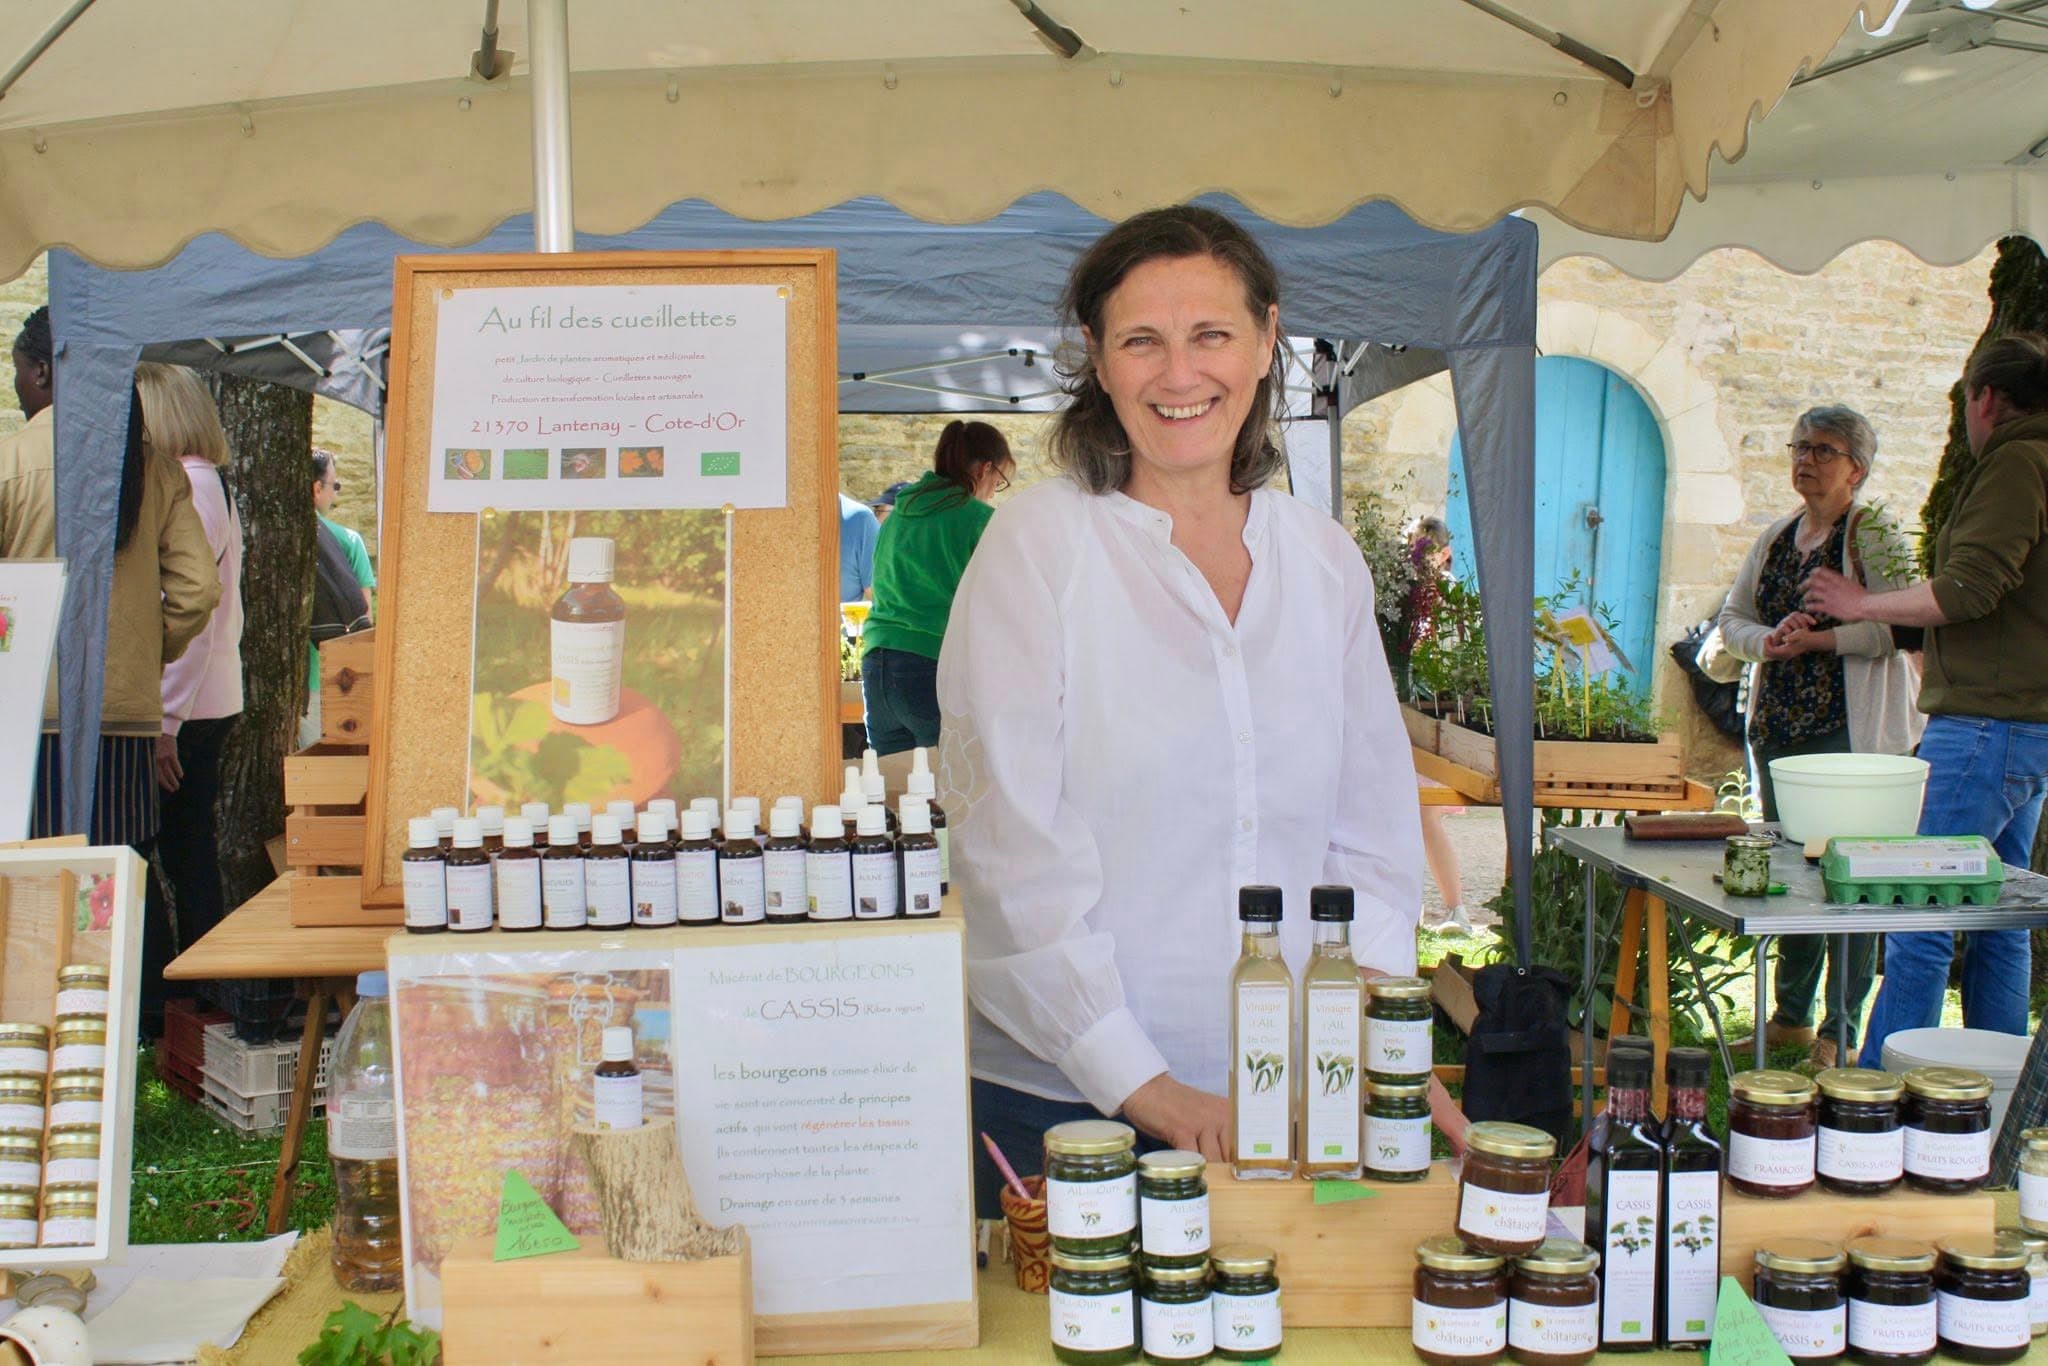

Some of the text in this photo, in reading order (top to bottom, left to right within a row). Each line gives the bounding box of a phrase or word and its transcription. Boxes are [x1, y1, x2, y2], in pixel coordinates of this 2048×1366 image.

[478, 303, 737, 333] Au fil des cueillettes
[495, 354, 516, 367] petit
[518, 354, 546, 364] Jardin
[547, 354, 557, 363] de
[559, 353, 592, 366] plantes
[593, 354, 645, 365] aromatiques
[646, 352, 656, 361] et
[502, 375, 514, 384] de
[515, 374, 544, 384] culture
[547, 374, 592, 385] biologique
[602, 372, 651, 384] Cueillettes
[653, 372, 692, 384] sauvages
[491, 393, 539, 406] Production
[551, 393, 614, 404] transformation
[615, 392, 646, 402] locales
[658, 390, 704, 401] artisanales
[471, 419, 529, 437] 21370
[537, 415, 621, 437] Lantenay
[784, 961, 916, 984] BOURGEONS
[760, 995, 861, 1022] CASSIS
[713, 1063, 737, 1082] les
[740, 1061, 828, 1084] bourgeons
[831, 1067, 870, 1077] comme
[902, 1061, 918, 1074] de
[714, 1100, 730, 1110] vie
[733, 1098, 760, 1110] sont
[761, 1098, 777, 1109] un
[838, 1091, 855, 1105] de
[858, 1092, 912, 1108] principes
[715, 1120, 749, 1135] actifs
[753, 1122, 771, 1137] qui
[772, 1121, 798, 1133] vont
[800, 1118, 857, 1135] régénérer
[858, 1115, 876, 1128] les
[731, 1144, 801, 1158] contiennent
[802, 1143, 840, 1155] toutes
[842, 1138, 861, 1152] les
[861, 1138, 902, 1156] étapes
[903, 1137, 919, 1151] de
[718, 1166, 802, 1183] métamorphose
[803, 1163, 819, 1177] de
[820, 1163, 832, 1177] la
[719, 1196, 775, 1213] Drainage
[777, 1199, 794, 1208] en
[794, 1197, 820, 1208] cure
[821, 1192, 837, 1206] de
[848, 1194, 902, 1206] semaines
[1616, 1199, 1651, 1211] CASSIS
[1677, 1198, 1712, 1210] CASSIS
